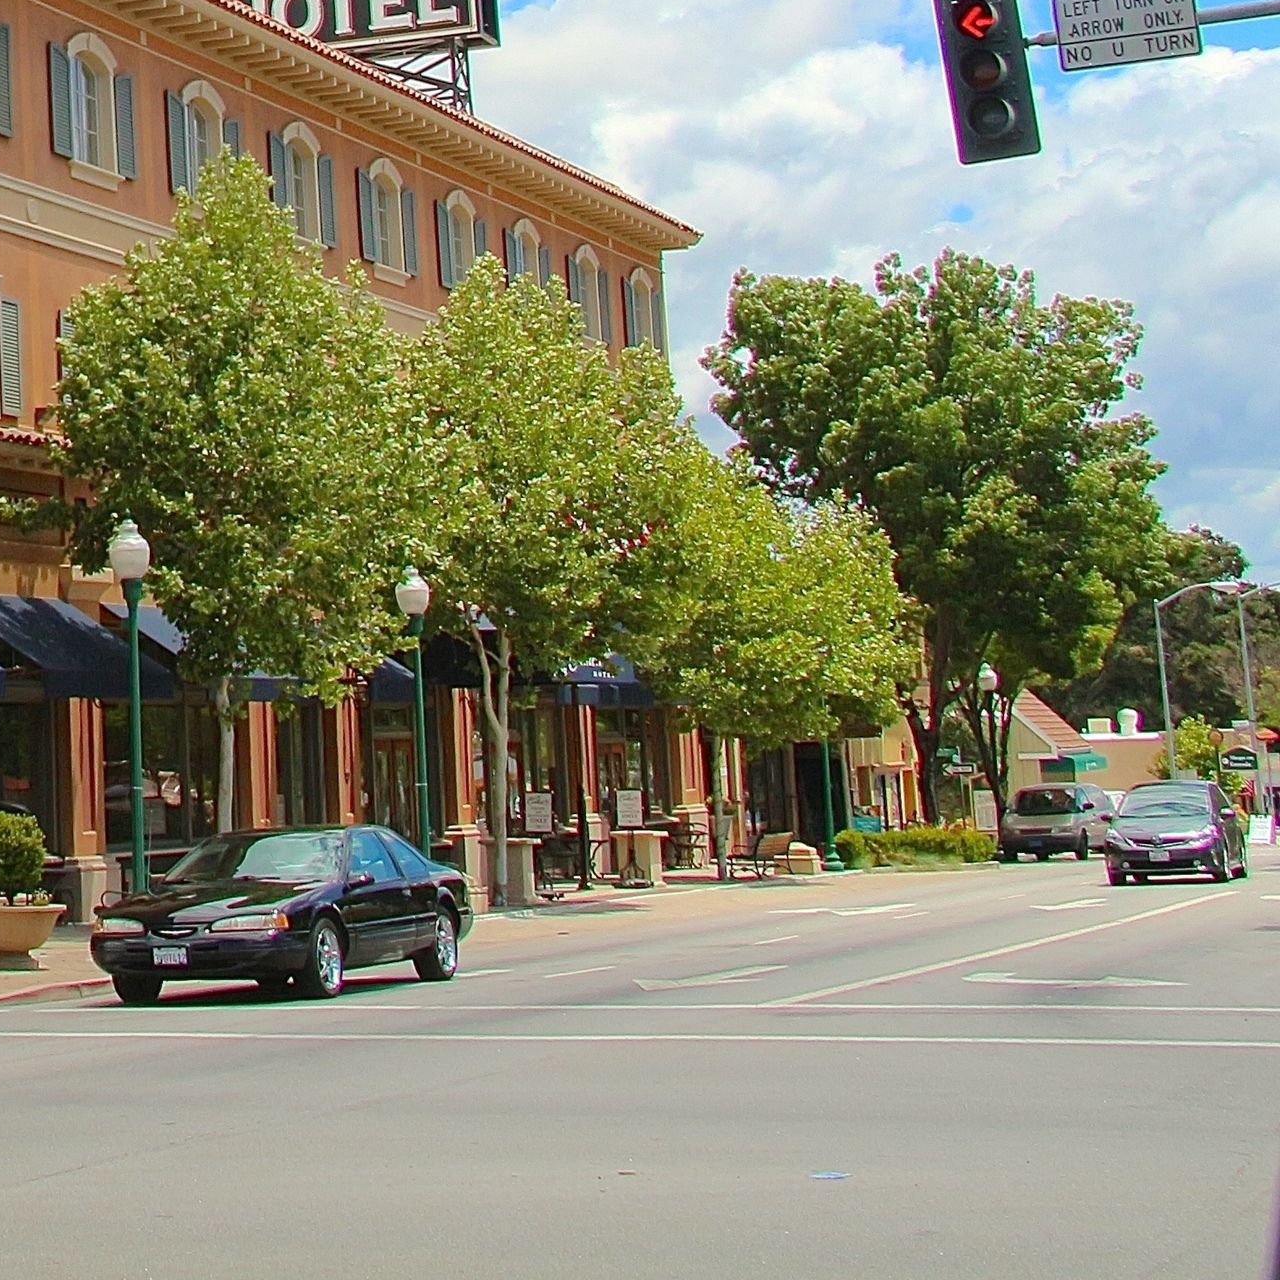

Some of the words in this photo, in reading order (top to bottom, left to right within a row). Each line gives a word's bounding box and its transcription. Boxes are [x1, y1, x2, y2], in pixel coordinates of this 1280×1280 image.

[1063, 0, 1100, 18] LEFT
[1071, 17, 1124, 37] ARROW
[1066, 45, 1092, 63] NO
[1112, 41, 1124, 57] U
[1144, 32, 1195, 53] TURN
